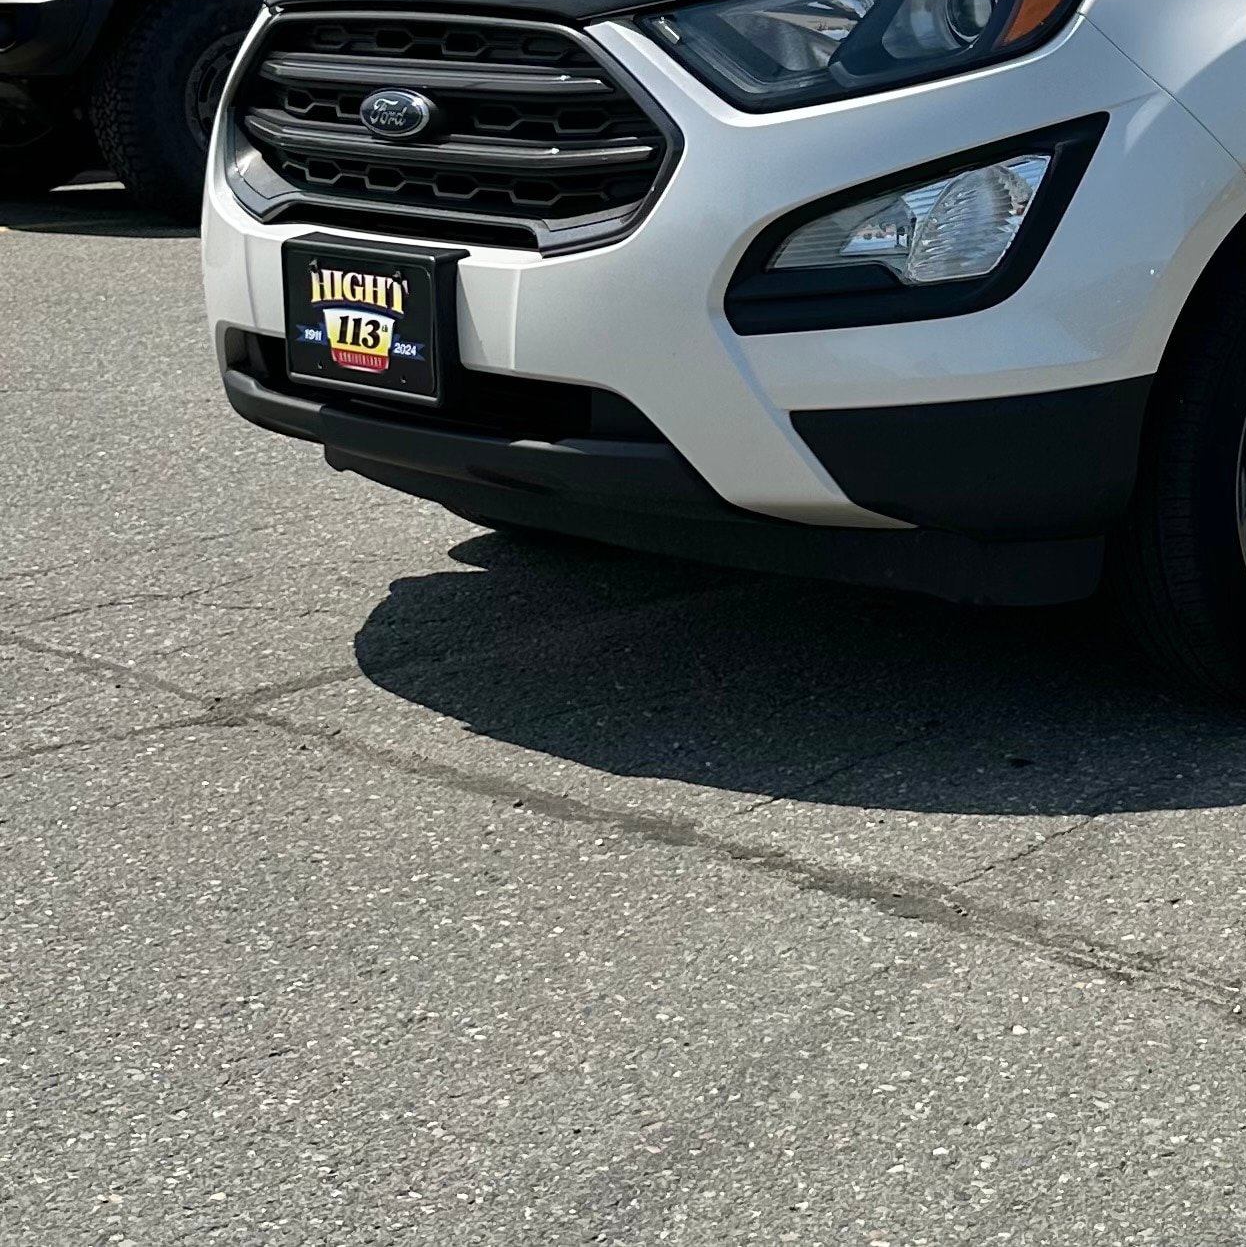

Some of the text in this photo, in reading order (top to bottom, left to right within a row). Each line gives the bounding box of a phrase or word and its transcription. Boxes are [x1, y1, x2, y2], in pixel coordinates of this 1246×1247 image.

[370, 98, 407, 126] Ford
[311, 269, 409, 315] HIGHT
[304, 329, 322, 342] 1911
[394, 342, 417, 355] 2024
